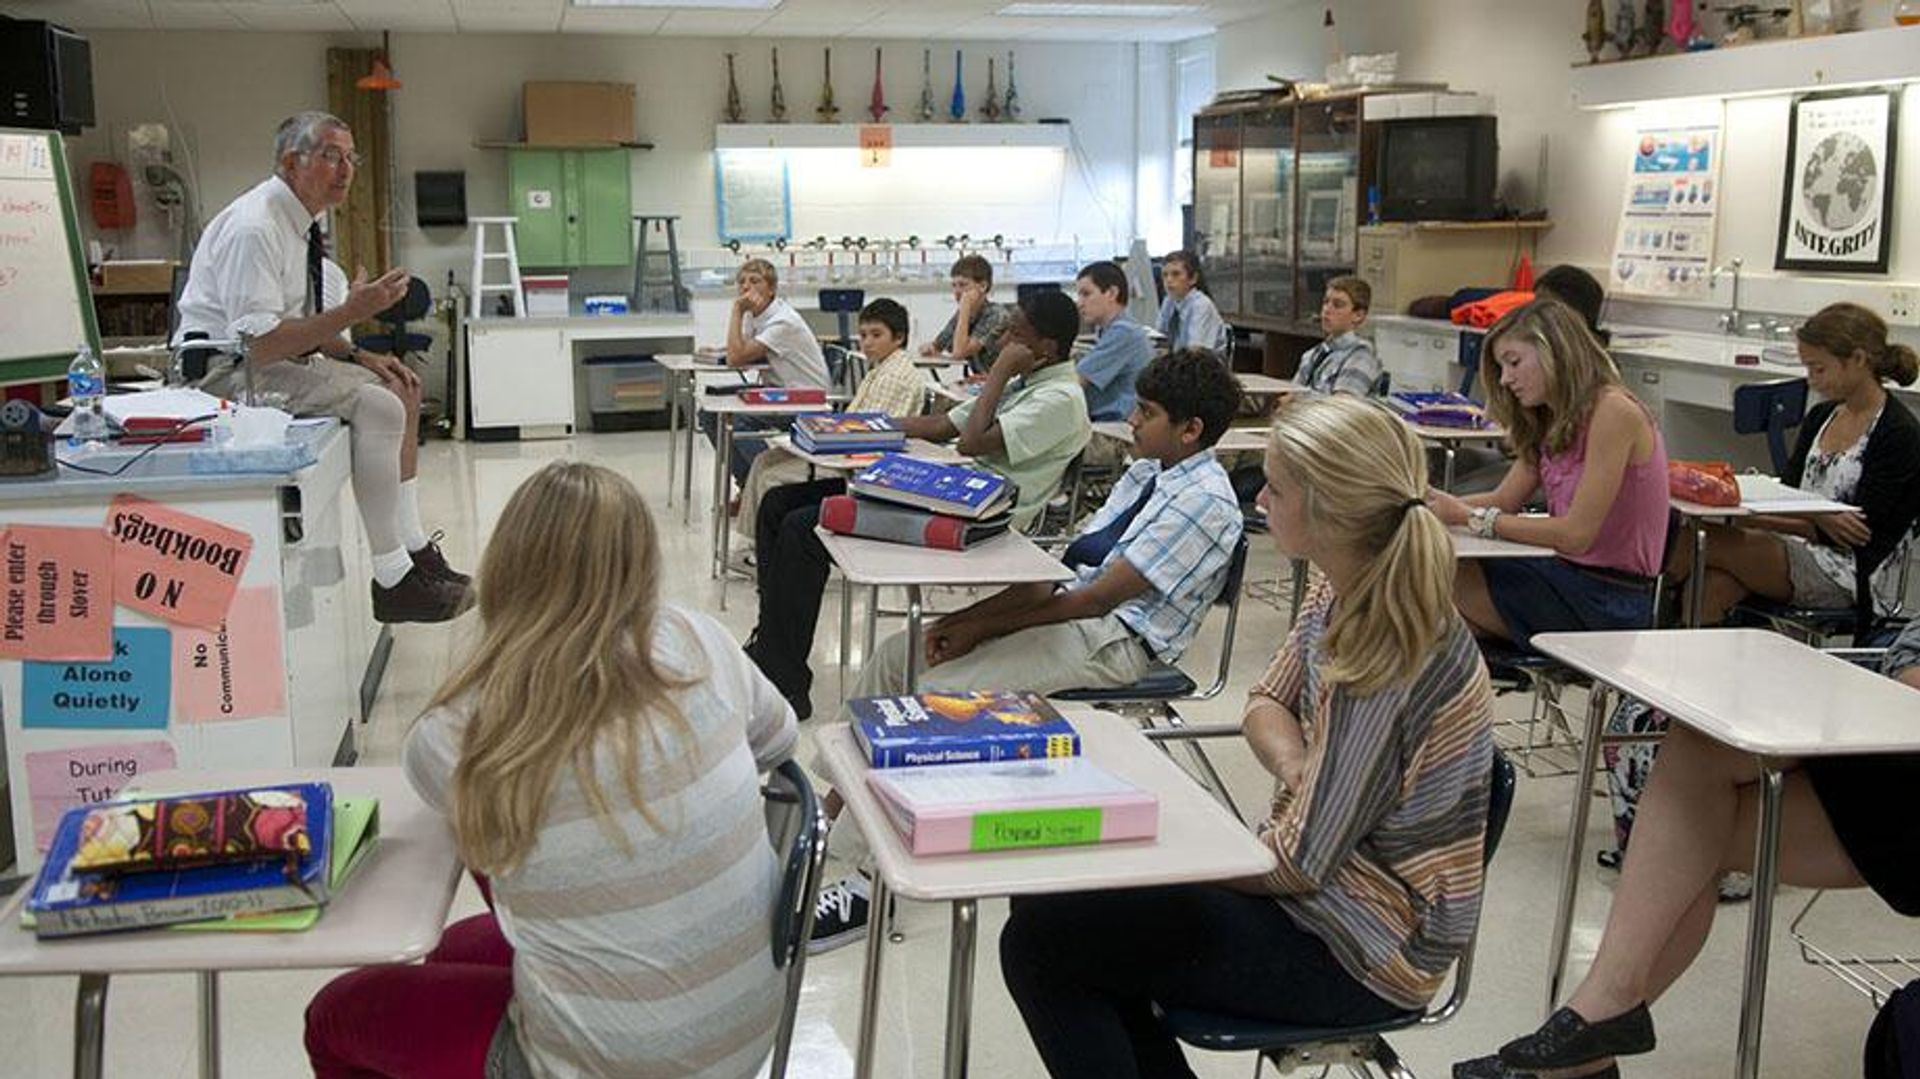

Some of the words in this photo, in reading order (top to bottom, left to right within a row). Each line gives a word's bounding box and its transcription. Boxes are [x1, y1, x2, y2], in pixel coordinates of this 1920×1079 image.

[1795, 219, 1877, 256] INTEGRITY
[112, 512, 243, 576] Bookbags
[7, 542, 26, 584] enter
[36, 561, 58, 624] through
[69, 568, 88, 618] Slover
[5, 588, 24, 640] Please
[63, 666, 132, 682] Alone
[193, 643, 208, 668] No
[215, 618, 233, 714] Communic
[53, 692, 140, 712] Quietly
[69, 757, 137, 778] During
[904, 749, 944, 766] Physical
[945, 749, 980, 762] Science
[77, 786, 119, 803] Tut
